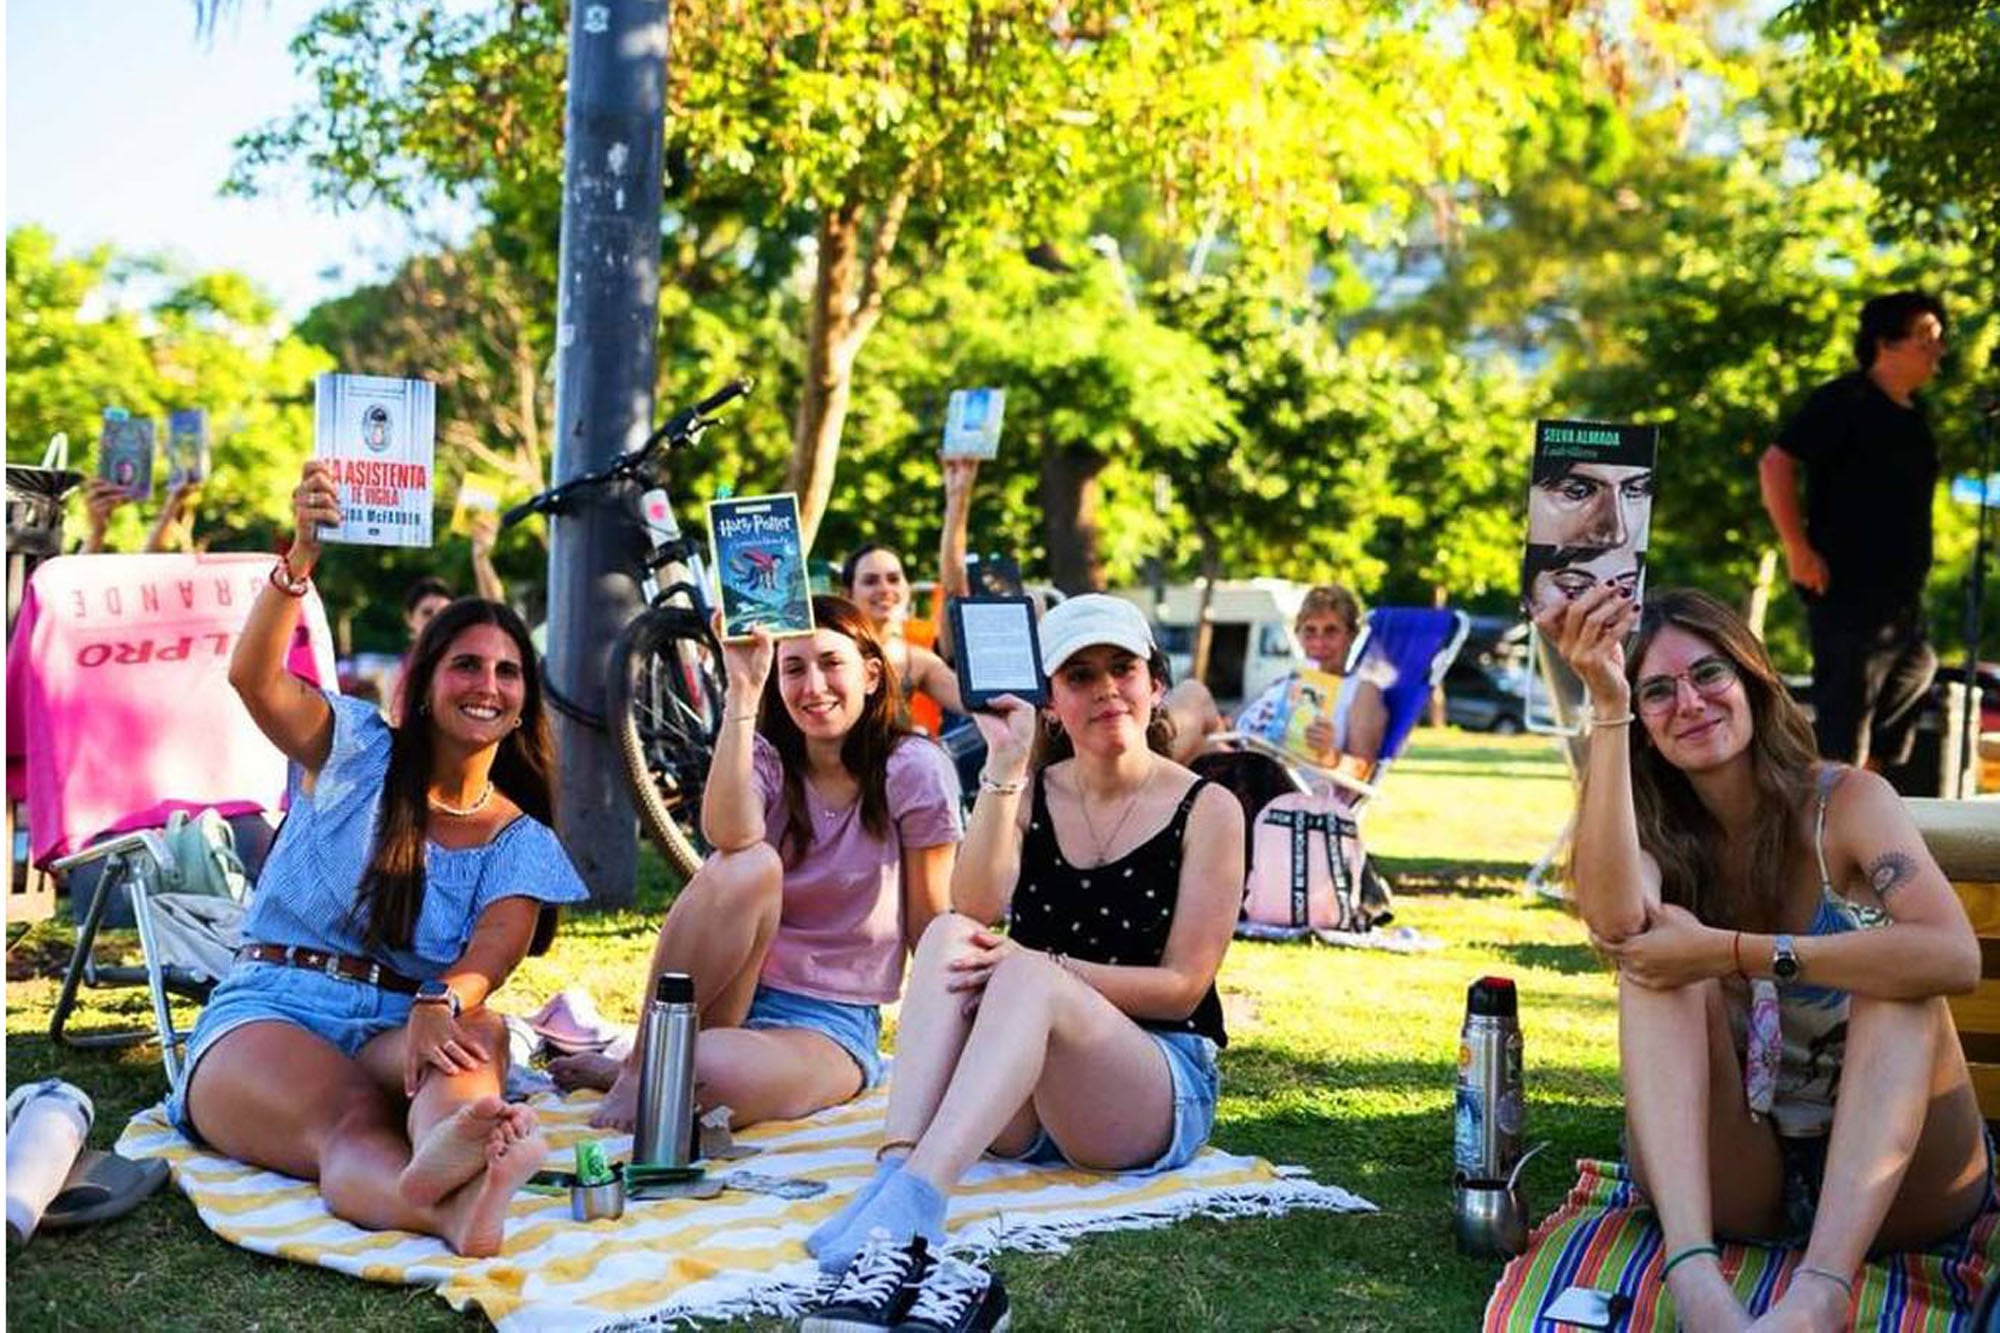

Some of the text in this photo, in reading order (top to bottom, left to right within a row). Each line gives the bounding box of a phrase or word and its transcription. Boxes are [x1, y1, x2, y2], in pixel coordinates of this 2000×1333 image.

[1544, 427, 1620, 446] SELVA ALMADA
[344, 461, 426, 490] ASISTENTA
[719, 514, 791, 538] Harry Potter
